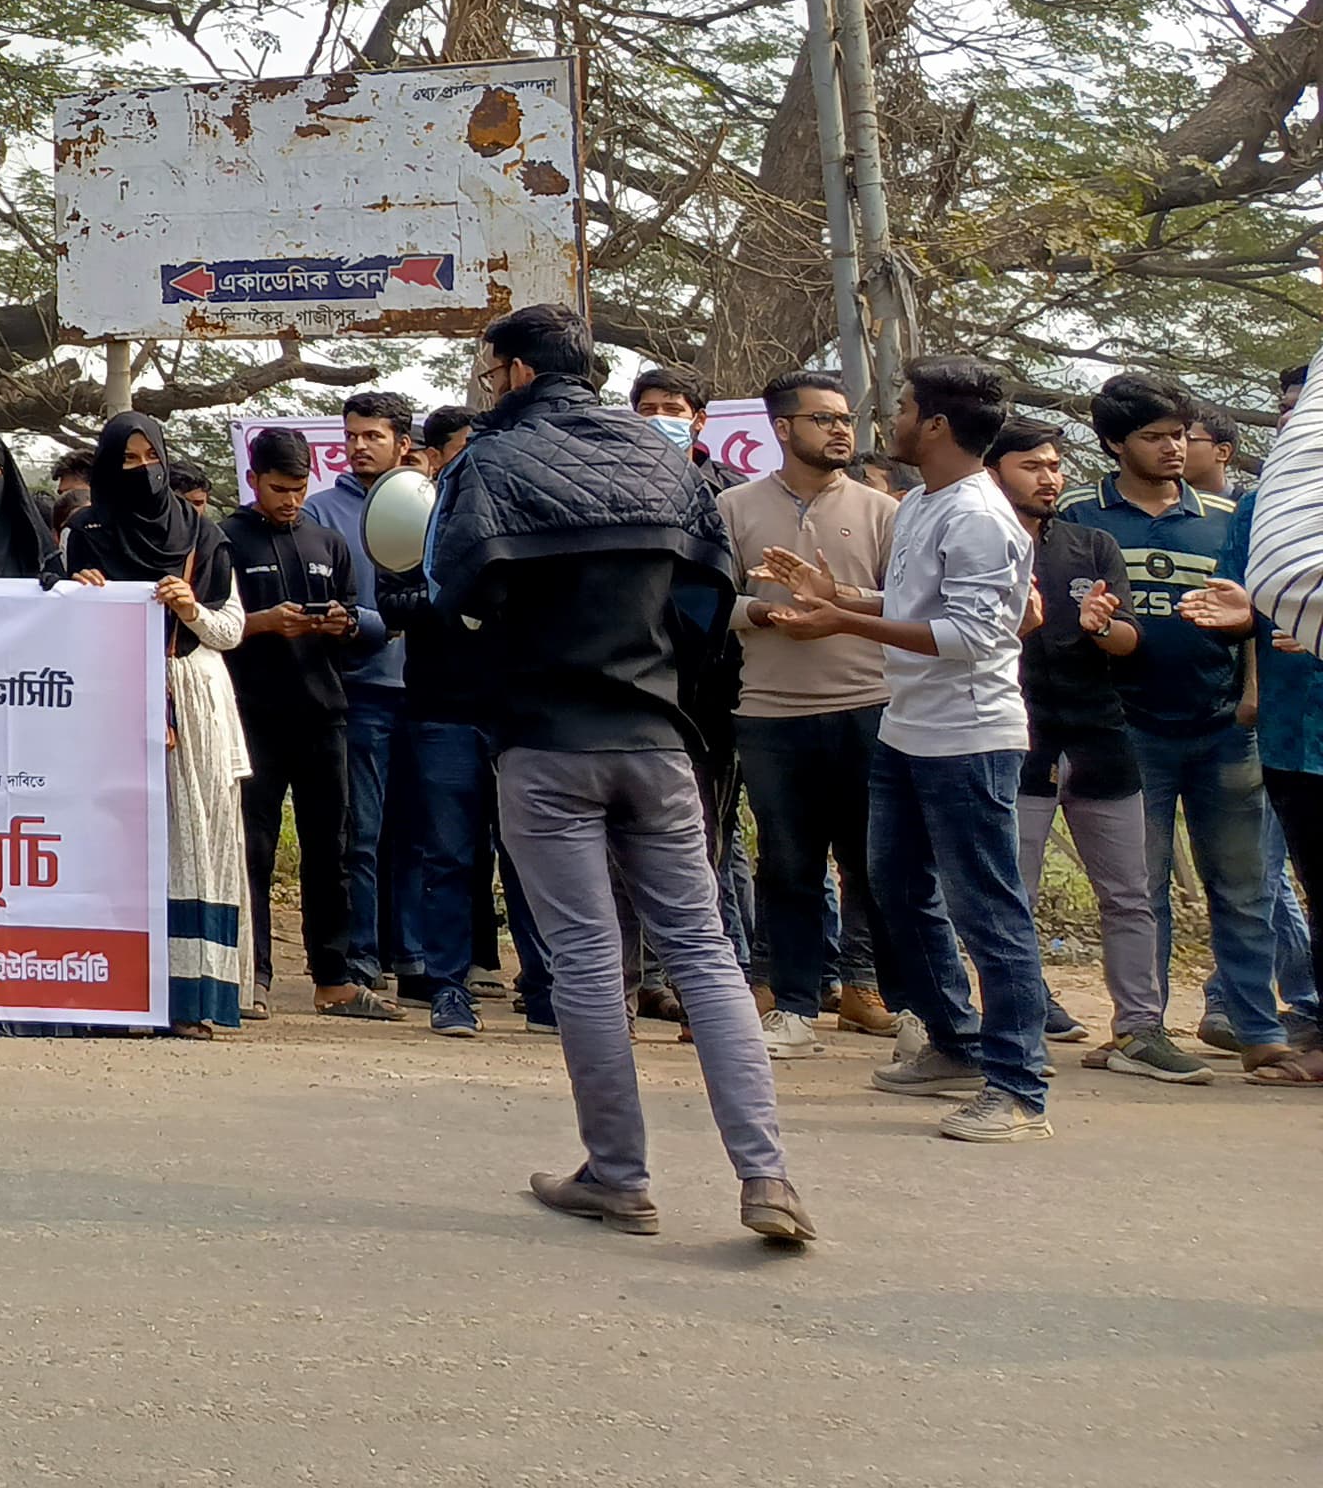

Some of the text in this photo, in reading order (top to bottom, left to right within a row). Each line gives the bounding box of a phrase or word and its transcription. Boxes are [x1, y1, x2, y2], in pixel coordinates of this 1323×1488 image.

[218, 266, 387, 295] একাডেমিক ভবন
[7, 772, 45, 789] দাবিতে
